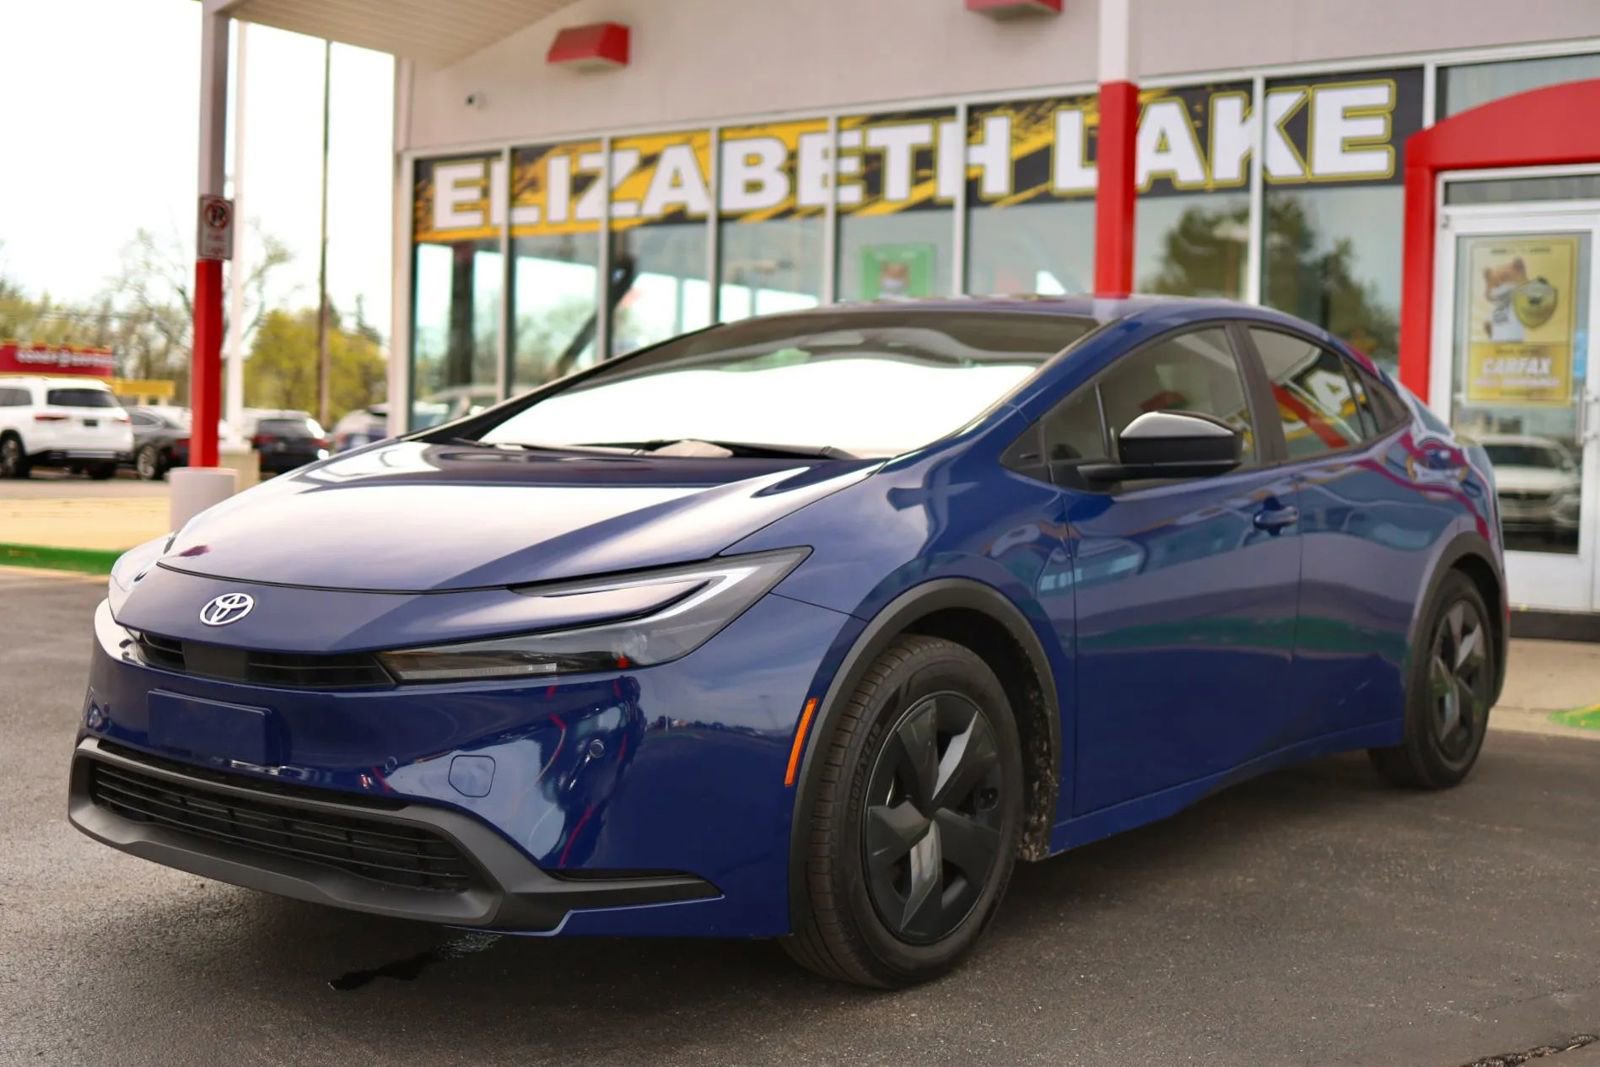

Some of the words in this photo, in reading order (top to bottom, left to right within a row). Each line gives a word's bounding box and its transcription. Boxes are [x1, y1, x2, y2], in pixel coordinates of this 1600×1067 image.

[432, 114, 1012, 230] ELIZABETH
[1052, 82, 1394, 193] LAKE
[1483, 356, 1553, 376] CARFAX
